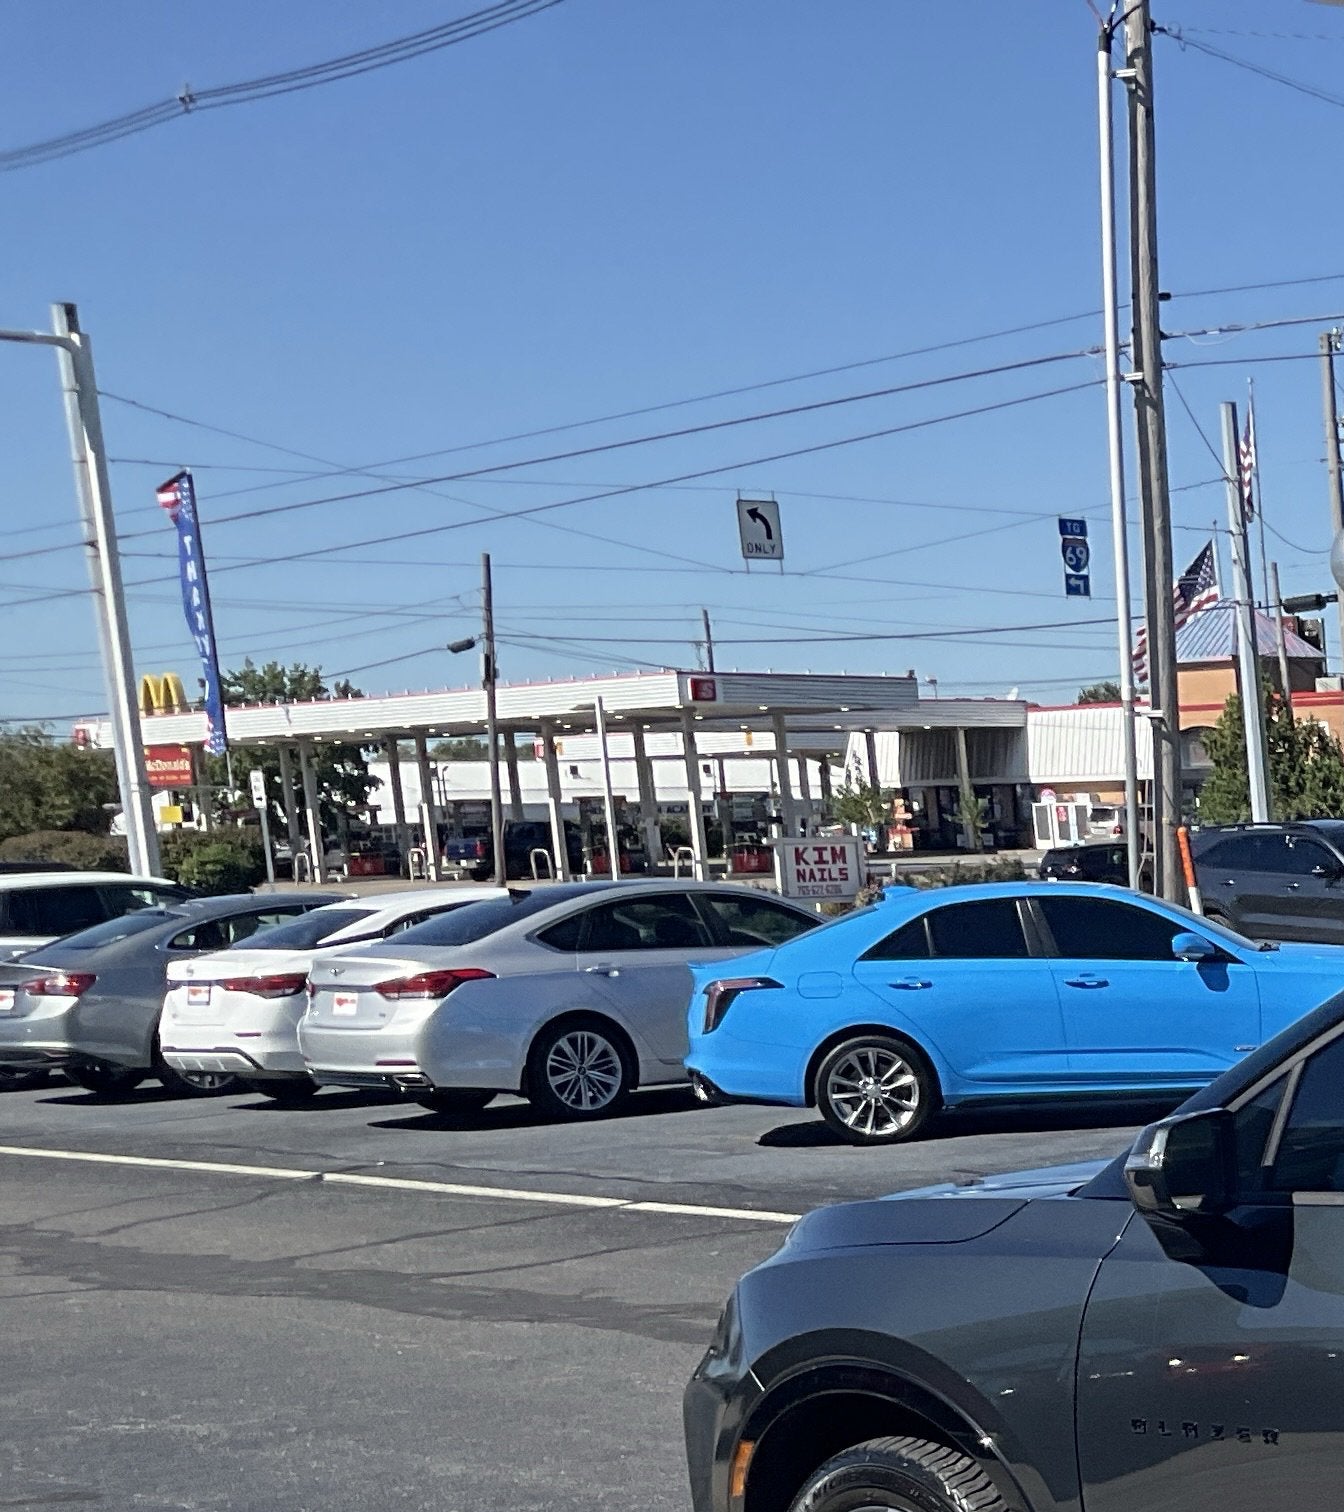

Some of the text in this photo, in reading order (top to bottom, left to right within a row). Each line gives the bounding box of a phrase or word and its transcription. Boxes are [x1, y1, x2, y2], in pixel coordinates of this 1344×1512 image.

[746, 542, 776, 554] ONLY
[1065, 546, 1088, 566] 69
[794, 845, 848, 866] KIM
[796, 867, 849, 883] NAILS
[1131, 1417, 1281, 1446] BLAZER
